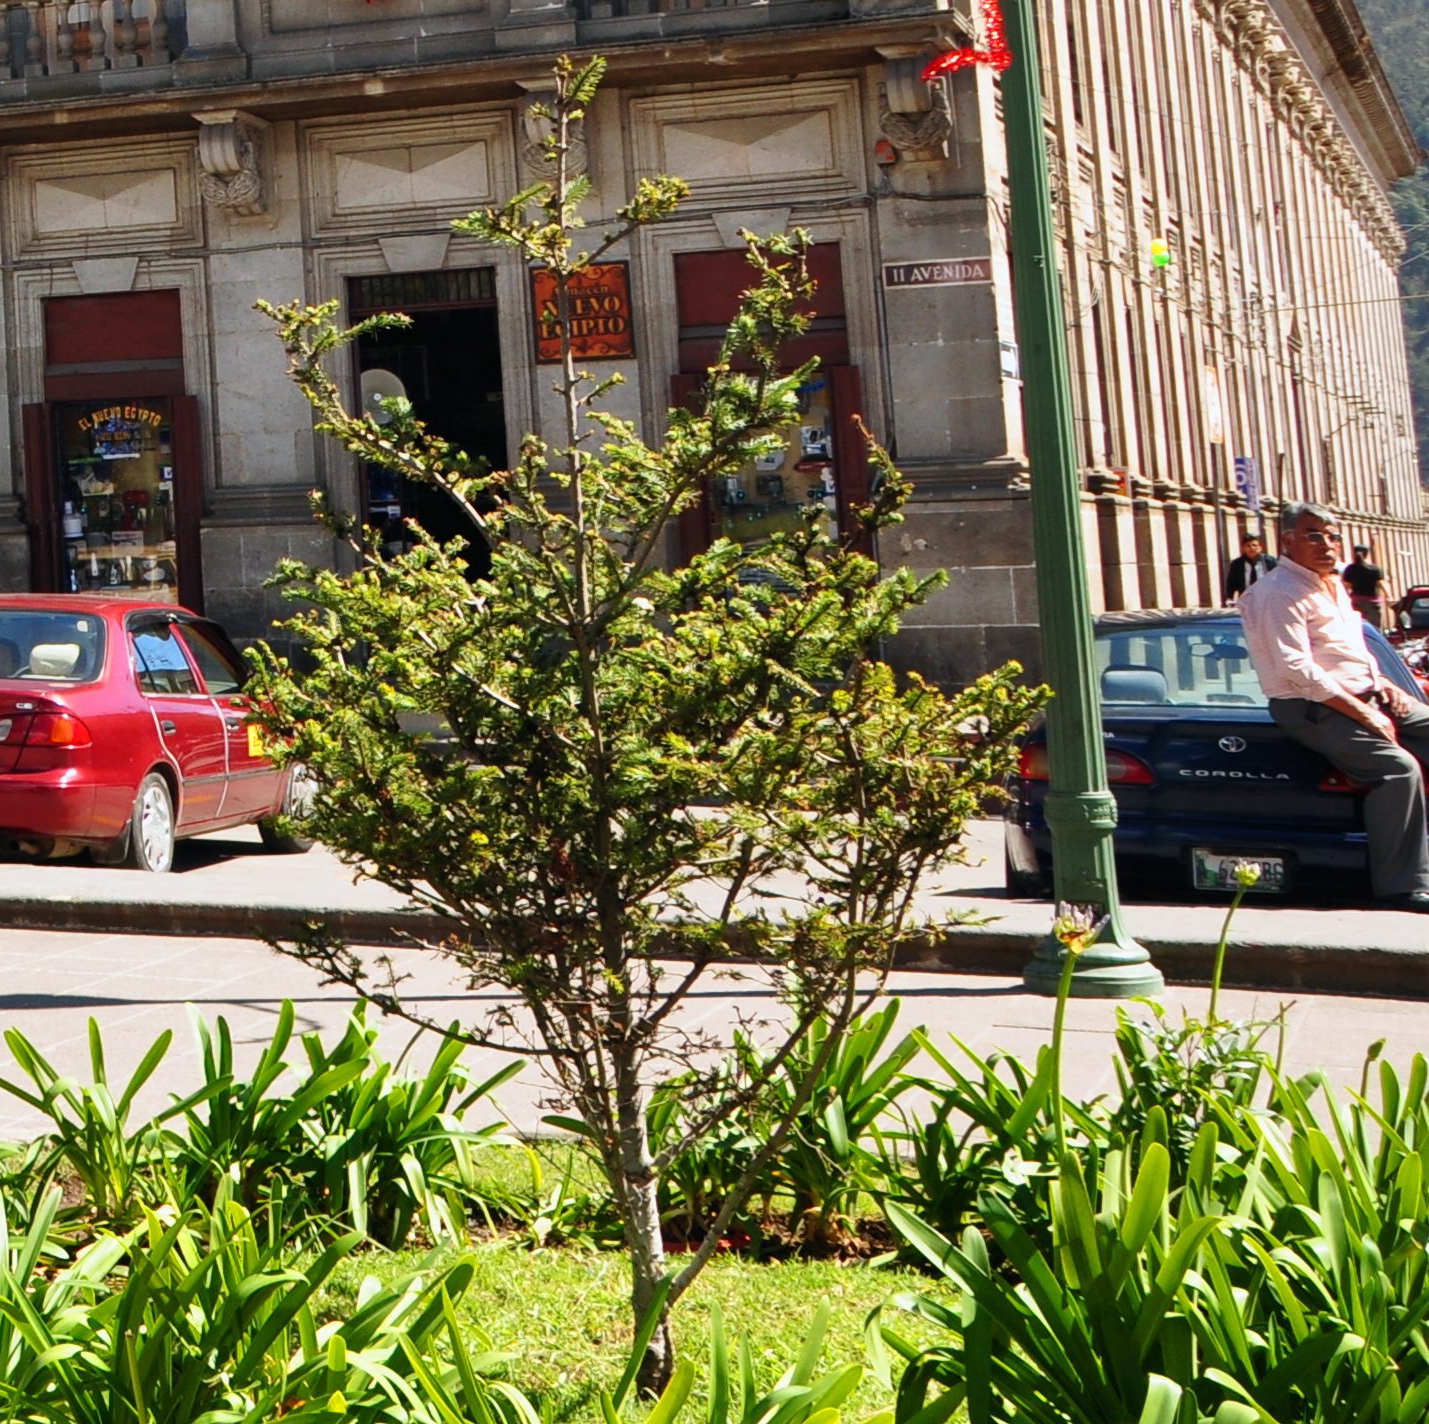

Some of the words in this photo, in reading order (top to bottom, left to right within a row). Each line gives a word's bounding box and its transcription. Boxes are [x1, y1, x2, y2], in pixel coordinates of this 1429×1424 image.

[892, 268, 905, 283] 11
[910, 264, 985, 282] AVENIDA
[125, 406, 162, 427] EGYPTO
[1179, 769, 1290, 780] COROLLA
